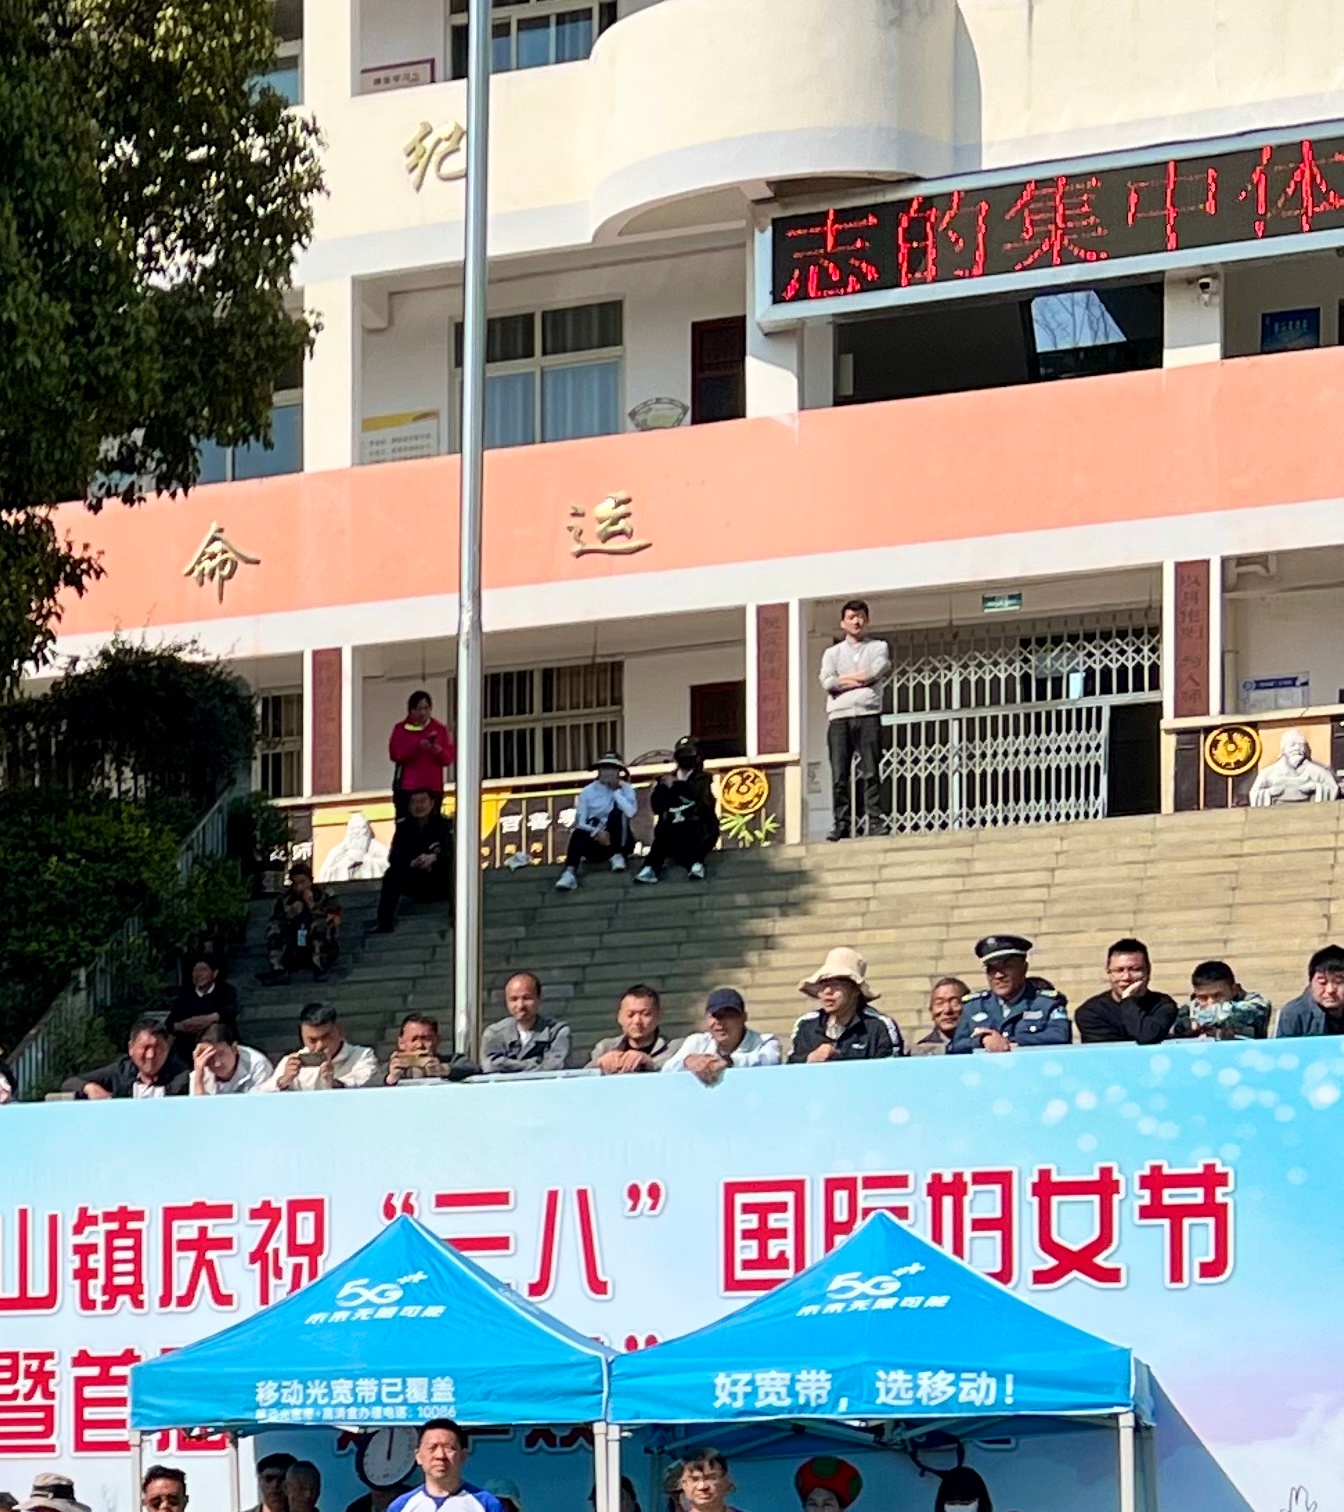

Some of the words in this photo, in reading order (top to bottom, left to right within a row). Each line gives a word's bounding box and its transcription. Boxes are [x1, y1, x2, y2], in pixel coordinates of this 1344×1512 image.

[780, 137, 1344, 304] 志的集中体
[182, 520, 262, 605] 命
[565, 489, 653, 559] 运
[255, 1376, 456, 1407] 移动光宽带已覆盖
[713, 1369, 1015, 1413] 好宽带，选移动！
